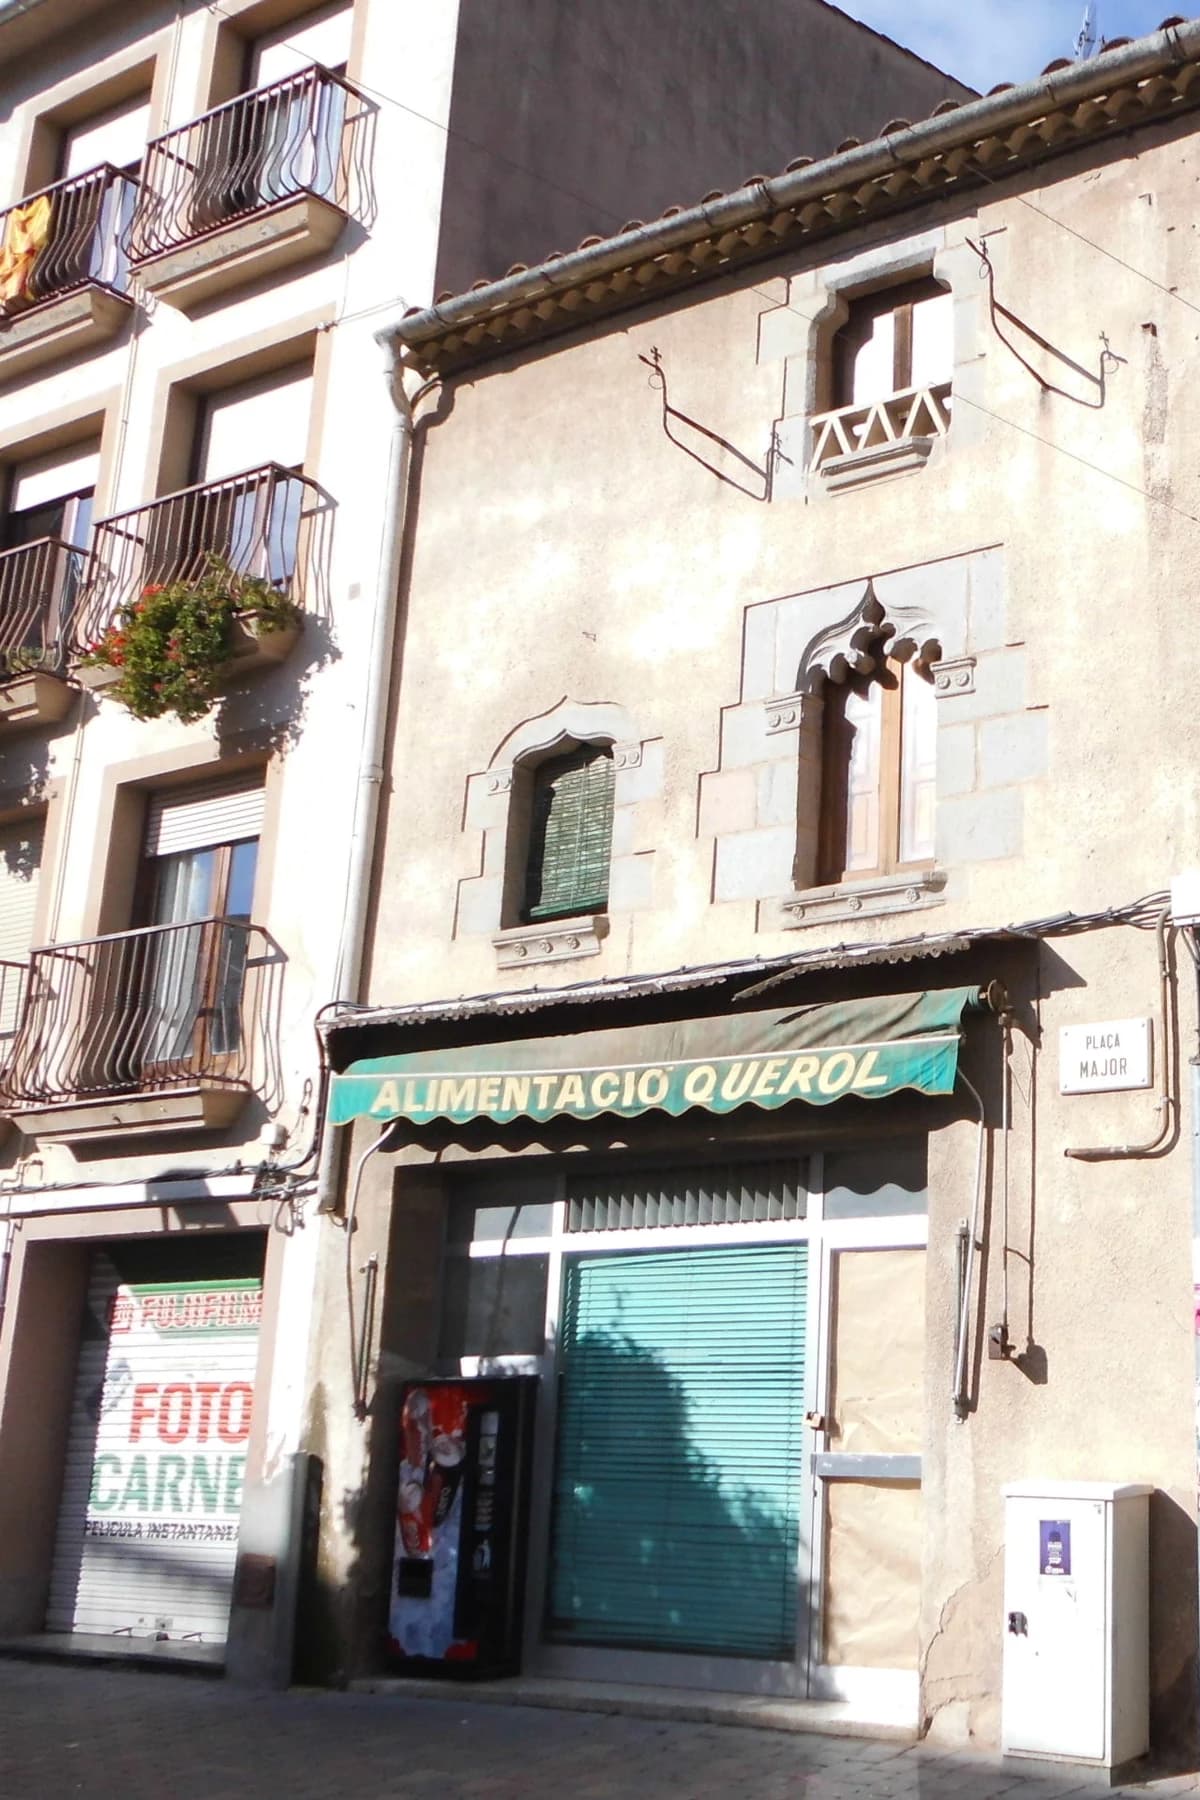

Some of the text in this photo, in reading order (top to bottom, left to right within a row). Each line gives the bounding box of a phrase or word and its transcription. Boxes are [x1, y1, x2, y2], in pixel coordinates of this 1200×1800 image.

[1085, 1033, 1121, 1050] PLAÇA
[684, 1051, 888, 1102] QUEROL
[1080, 1057, 1128, 1079] MAJOR
[139, 1291, 263, 1328] FUJIFILM
[128, 1381, 253, 1444] FOTO
